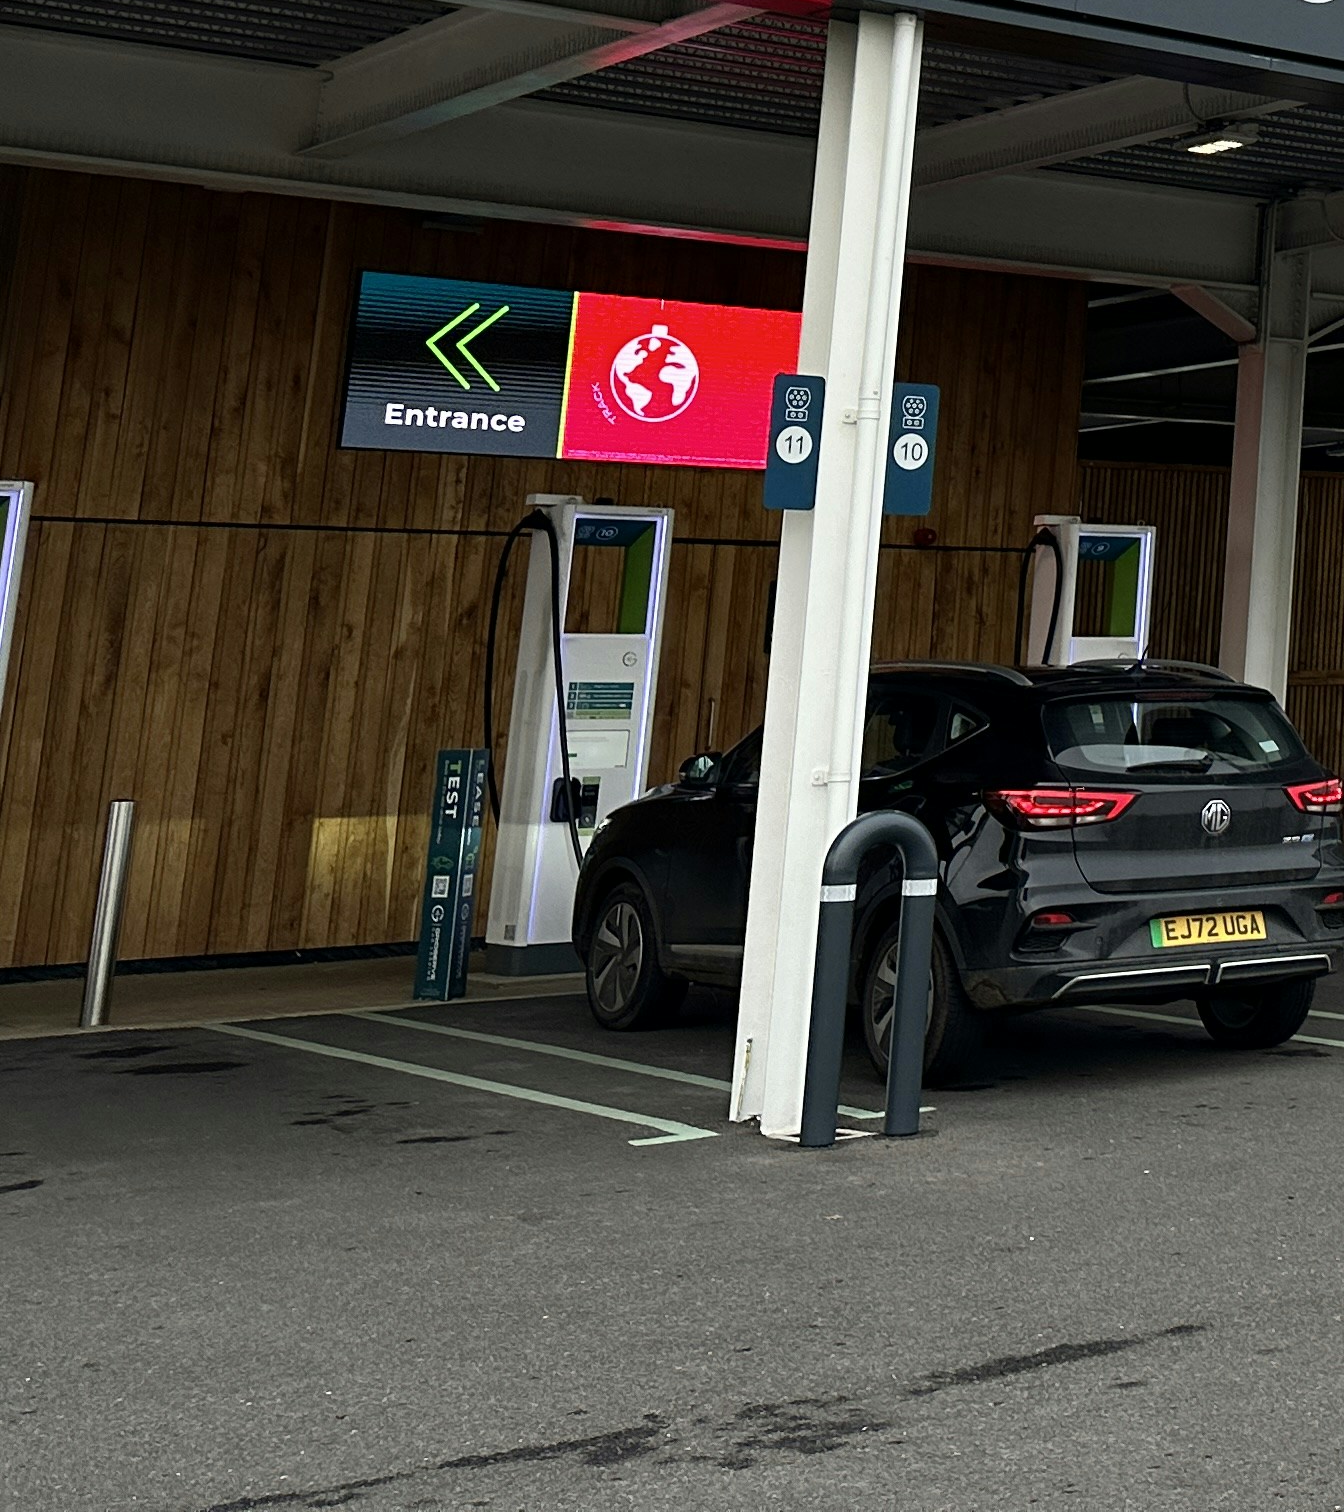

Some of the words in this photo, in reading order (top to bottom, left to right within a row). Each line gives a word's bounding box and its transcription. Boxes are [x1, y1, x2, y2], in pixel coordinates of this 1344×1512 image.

[384, 403, 526, 433] Entrance
[590, 381, 617, 425] TRACK
[784, 435, 804, 455] 11
[900, 442, 923, 462] 10
[445, 759, 462, 820] TEST
[1203, 801, 1230, 833] MG
[1164, 916, 1219, 941] EJ72
[1222, 913, 1261, 936] UGA
